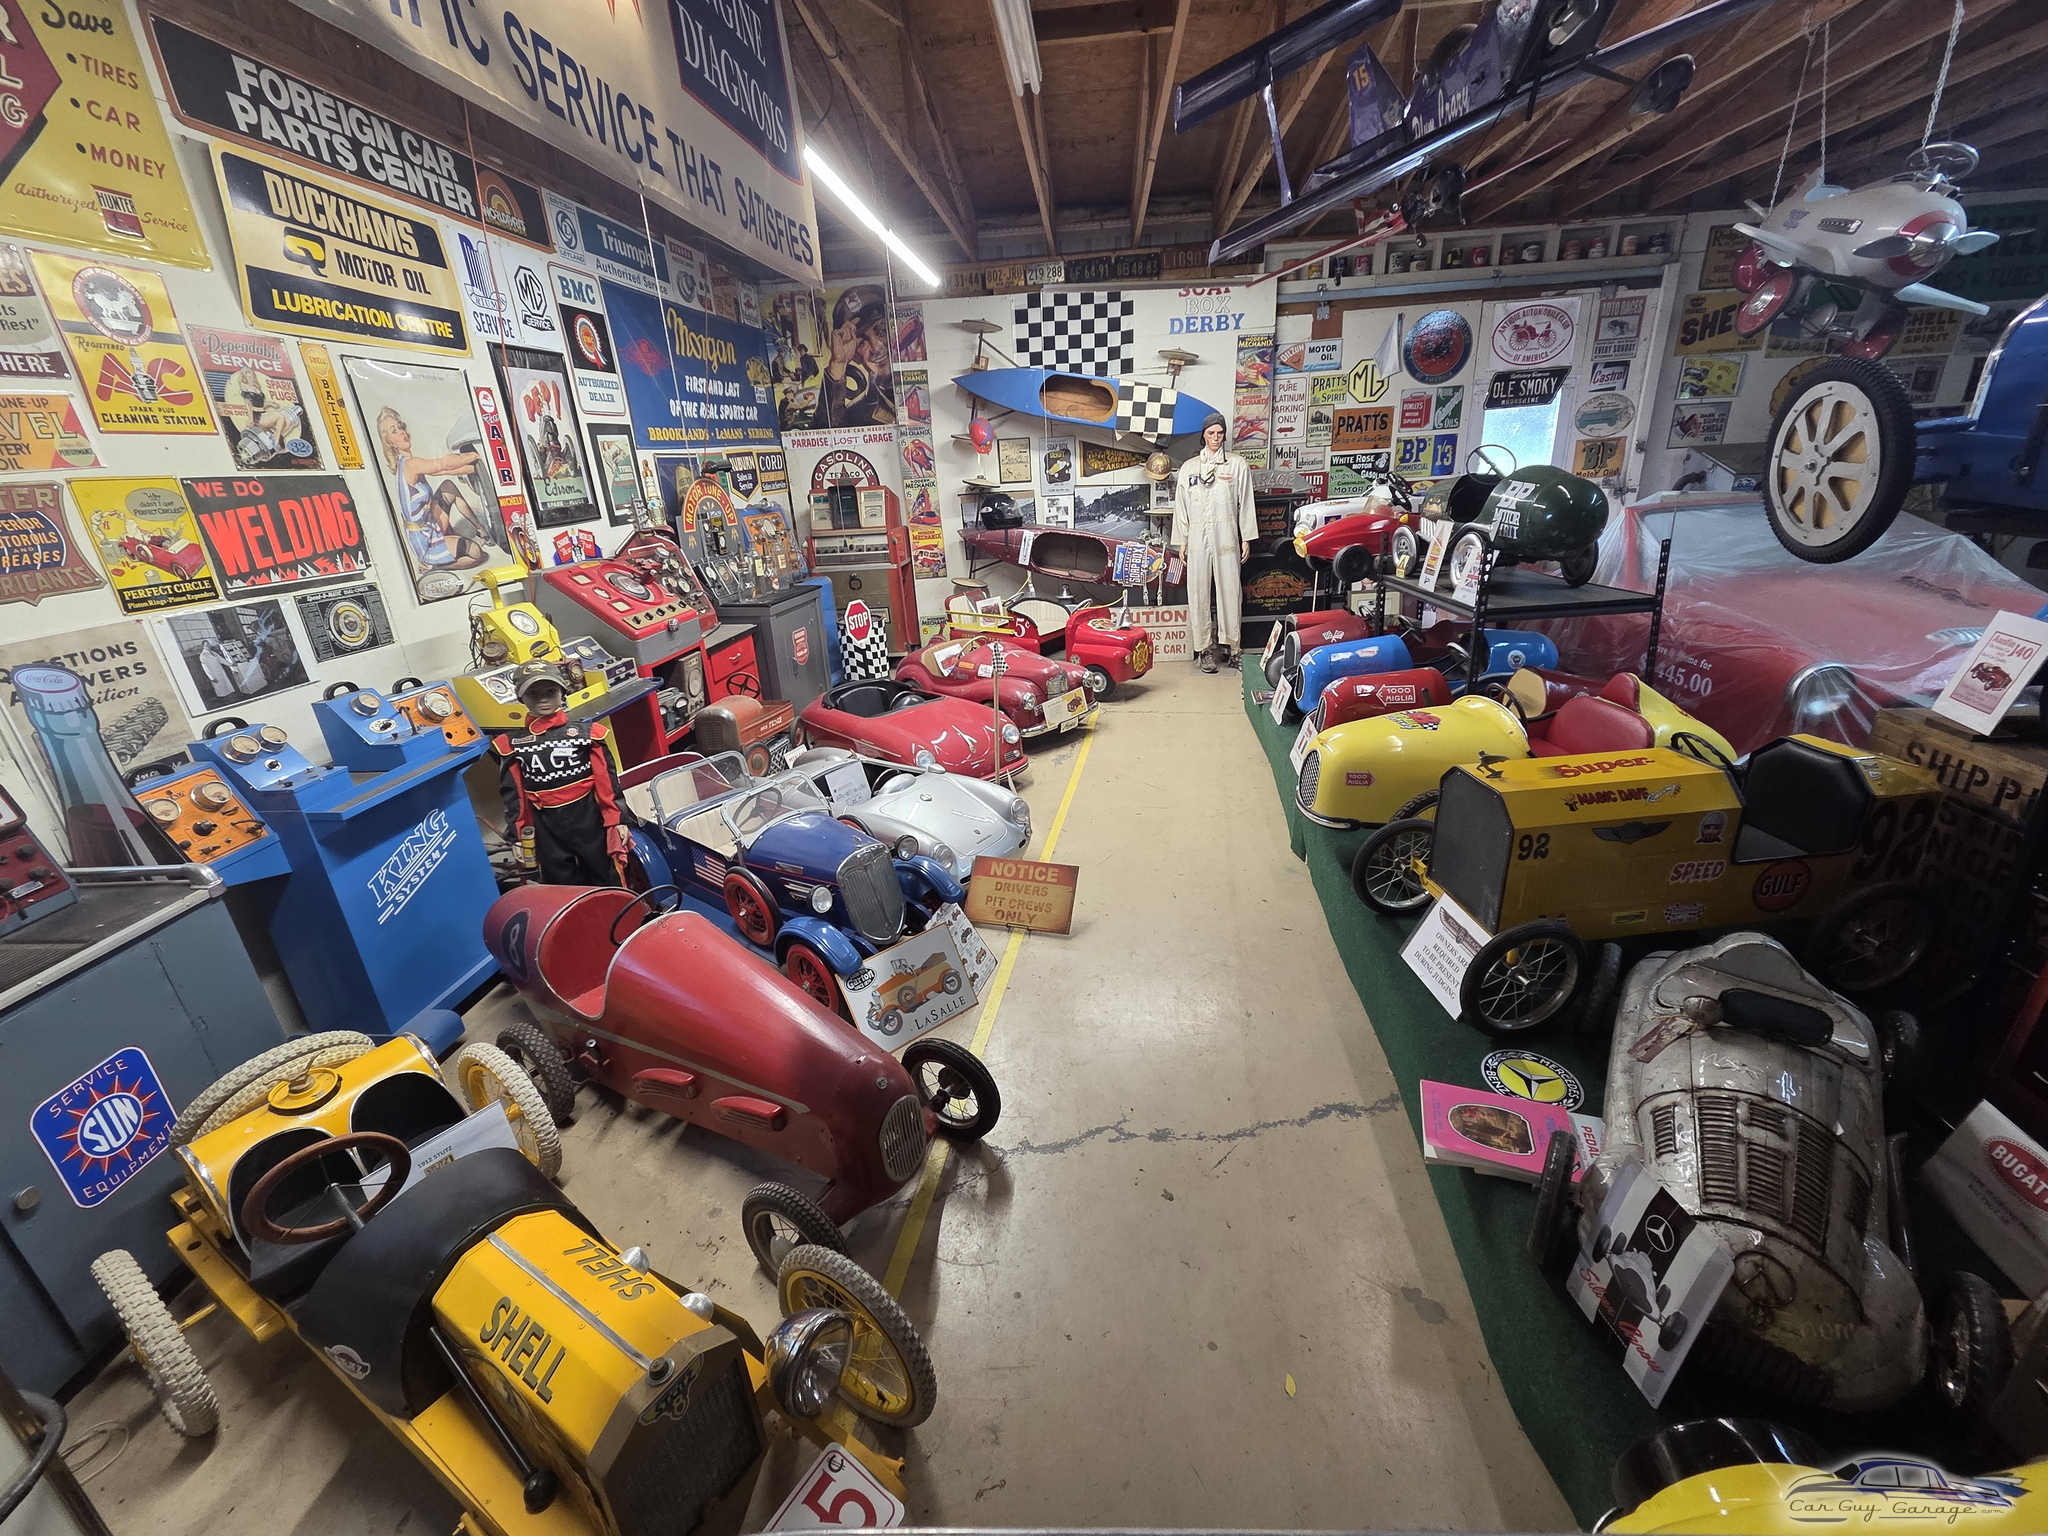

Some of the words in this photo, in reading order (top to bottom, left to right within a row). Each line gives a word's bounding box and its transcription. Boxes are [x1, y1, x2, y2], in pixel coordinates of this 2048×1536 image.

[41, 0, 114, 36] Save
[80, 53, 139, 90] TIRES
[675, 0, 788, 154] DIAGNOSIS
[1353, 70, 1371, 91] 15
[86, 100, 142, 133] CAR
[231, 54, 399, 155] FOREIGN
[400, 130, 459, 182] CAR
[503, 10, 665, 178] SERVICE
[665, 127, 727, 217] THAT
[734, 176, 814, 267] SATISFIES
[89, 143, 165, 180] MONEY
[225, 90, 358, 172] PARTS
[362, 145, 477, 218] CENTER
[15, 182, 98, 213] Authorized
[96, 192, 137, 215] HUNTER
[141, 212, 188, 233] Service
[262, 170, 420, 258] DUCKHAMS
[560, 249, 585, 262] LEYLAND
[596, 223, 655, 269] Triumph
[334, 248, 398, 288] MOTOR
[403, 267, 431, 296] OIL
[596, 257, 641, 285] Authorized
[1028, 267, 1044, 281] 219
[1046, 266, 1063, 279] 288
[557, 274, 596, 305] BMC
[271, 289, 392, 329] LUBRICATION
[395, 313, 454, 339] CENTRE
[1184, 296, 1232, 316] BOX
[1601, 302, 1620, 317] AUTO
[1621, 300, 1644, 315] RACES
[525, 316, 552, 330] SERVICE
[1169, 312, 1245, 335] DERBY
[1497, 312, 1521, 335] ANTIQUE
[1522, 307, 1558, 320] AUTOMOBILE
[201, 332, 282, 361] Dependable
[667, 307, 737, 374] Morgan
[1238, 339, 1274, 348] MECHANIX
[1903, 332, 1950, 344] SPIRIT
[1280, 343, 1306, 362] OILZUM
[1308, 344, 1338, 354] MOTOR
[1320, 353, 1334, 361] OIL
[1513, 354, 1521, 362] OF
[1521, 351, 1550, 362] AMERICA
[1594, 344, 1612, 355] EVERY
[1612, 343, 1636, 353] SUNDAY
[211, 353, 283, 373] SERVICE
[308, 355, 327, 365] SHELL
[265, 379, 294, 391] SPARK
[578, 376, 620, 390] AUTHORIZED
[685, 375, 707, 394] FIRST
[708, 379, 723, 397] AND
[724, 382, 741, 398] LAST
[1278, 382, 1298, 392] PURE
[1423, 371, 1453, 383] AMERICA
[1592, 369, 1627, 385] Castrol
[269, 390, 297, 401] PLUGS
[588, 391, 616, 403] DEALER
[1321, 392, 1346, 403] SPIRIT
[1492, 380, 1516, 399] OLE
[1519, 376, 1559, 396] SMOKY
[682, 400, 698, 418] THE
[720, 405, 745, 421] SPORTS
[746, 406, 759, 421] CAR
[1500, 396, 1539, 406] MOONSHINE
[101, 413, 159, 425] CLEANING
[164, 414, 207, 426] STATION
[320, 379, 351, 455] BATTERY
[1277, 414, 1298, 424] ONLY
[1444, 418, 1459, 428] OILS
[1703, 417, 1725, 425] SUPER
[647, 427, 710, 441] BROOKLANDS
[794, 429, 832, 437] EVERYTHING
[1701, 424, 1724, 433] SHELL
[791, 437, 829, 448] PARADISE
[833, 436, 859, 446] LOST
[862, 432, 893, 443] GARAGE
[490, 425, 513, 483] AIR
[759, 454, 783, 471] CORD
[1332, 455, 1355, 465] WHITE
[1355, 454, 1376, 463] ROSE
[1582, 441, 1619, 470] BP
[814, 452, 875, 482] GASOLINE
[829, 471, 861, 479] TEXACO
[1396, 462, 1429, 472] COMMERCIAL
[1575, 470, 1599, 478] Motor
[191, 481, 227, 498] WE
[232, 481, 265, 497] DO
[544, 477, 582, 496] Edison
[1334, 485, 1363, 494] MOTOR
[1496, 480, 1537, 510] BP
[685, 485, 704, 525] MOTOR
[199, 491, 360, 576] WELDING
[123, 585, 172, 600] PERFECT
[173, 580, 211, 592] CIRCLE
[848, 615, 869, 631] STOP
[1164, 631, 1186, 641] AND
[1992, 635, 2016, 648] Austin
[1163, 643, 1186, 654] CAR!
[2007, 644, 2034, 660] J40
[1904, 740, 1990, 795] SHIP
[1576, 790, 1618, 806] MAGIC
[1618, 786, 1649, 803] DAVE
[1517, 832, 1550, 861] 92
[366, 807, 451, 909] KING
[395, 850, 443, 904] SYSTEM
[989, 861, 1059, 884] NOTICE
[1670, 859, 1726, 884] SPEED
[994, 881, 1049, 898] DRIVERS
[1758, 872, 1804, 897] GULF
[984, 895, 1006, 907] PIT
[1008, 898, 1053, 913] CREWS
[994, 909, 1038, 925] ONLY
[1432, 943, 1460, 973] REQUIRED
[1435, 931, 1457, 956] OWNERS
[1456, 955, 1470, 968] ARE
[1414, 950, 1434, 974] DURING
[1432, 972, 1457, 1000] JUDGING
[1421, 945, 1430, 956] TO
[1428, 953, 1437, 964] BE
[1435, 961, 1460, 988] PRESENT
[846, 970, 875, 990] Garton
[49, 1058, 129, 1118] SERVICE
[1485, 1069, 1507, 1095] BENZ
[1539, 1058, 1580, 1101] MERCEDES
[83, 1093, 140, 1154] SUN
[1581, 1124, 1599, 1158] PEDAL
[82, 1120, 173, 1200] EQUIPMENT
[433, 1145, 453, 1159] STUTZ
[561, 1237, 658, 1302] SHELL
[1579, 1266, 1616, 1319] Silver
[1618, 1320, 1665, 1376] Arrow
[478, 1296, 568, 1405] SHELL
[802, 1469, 877, 1528] 5
